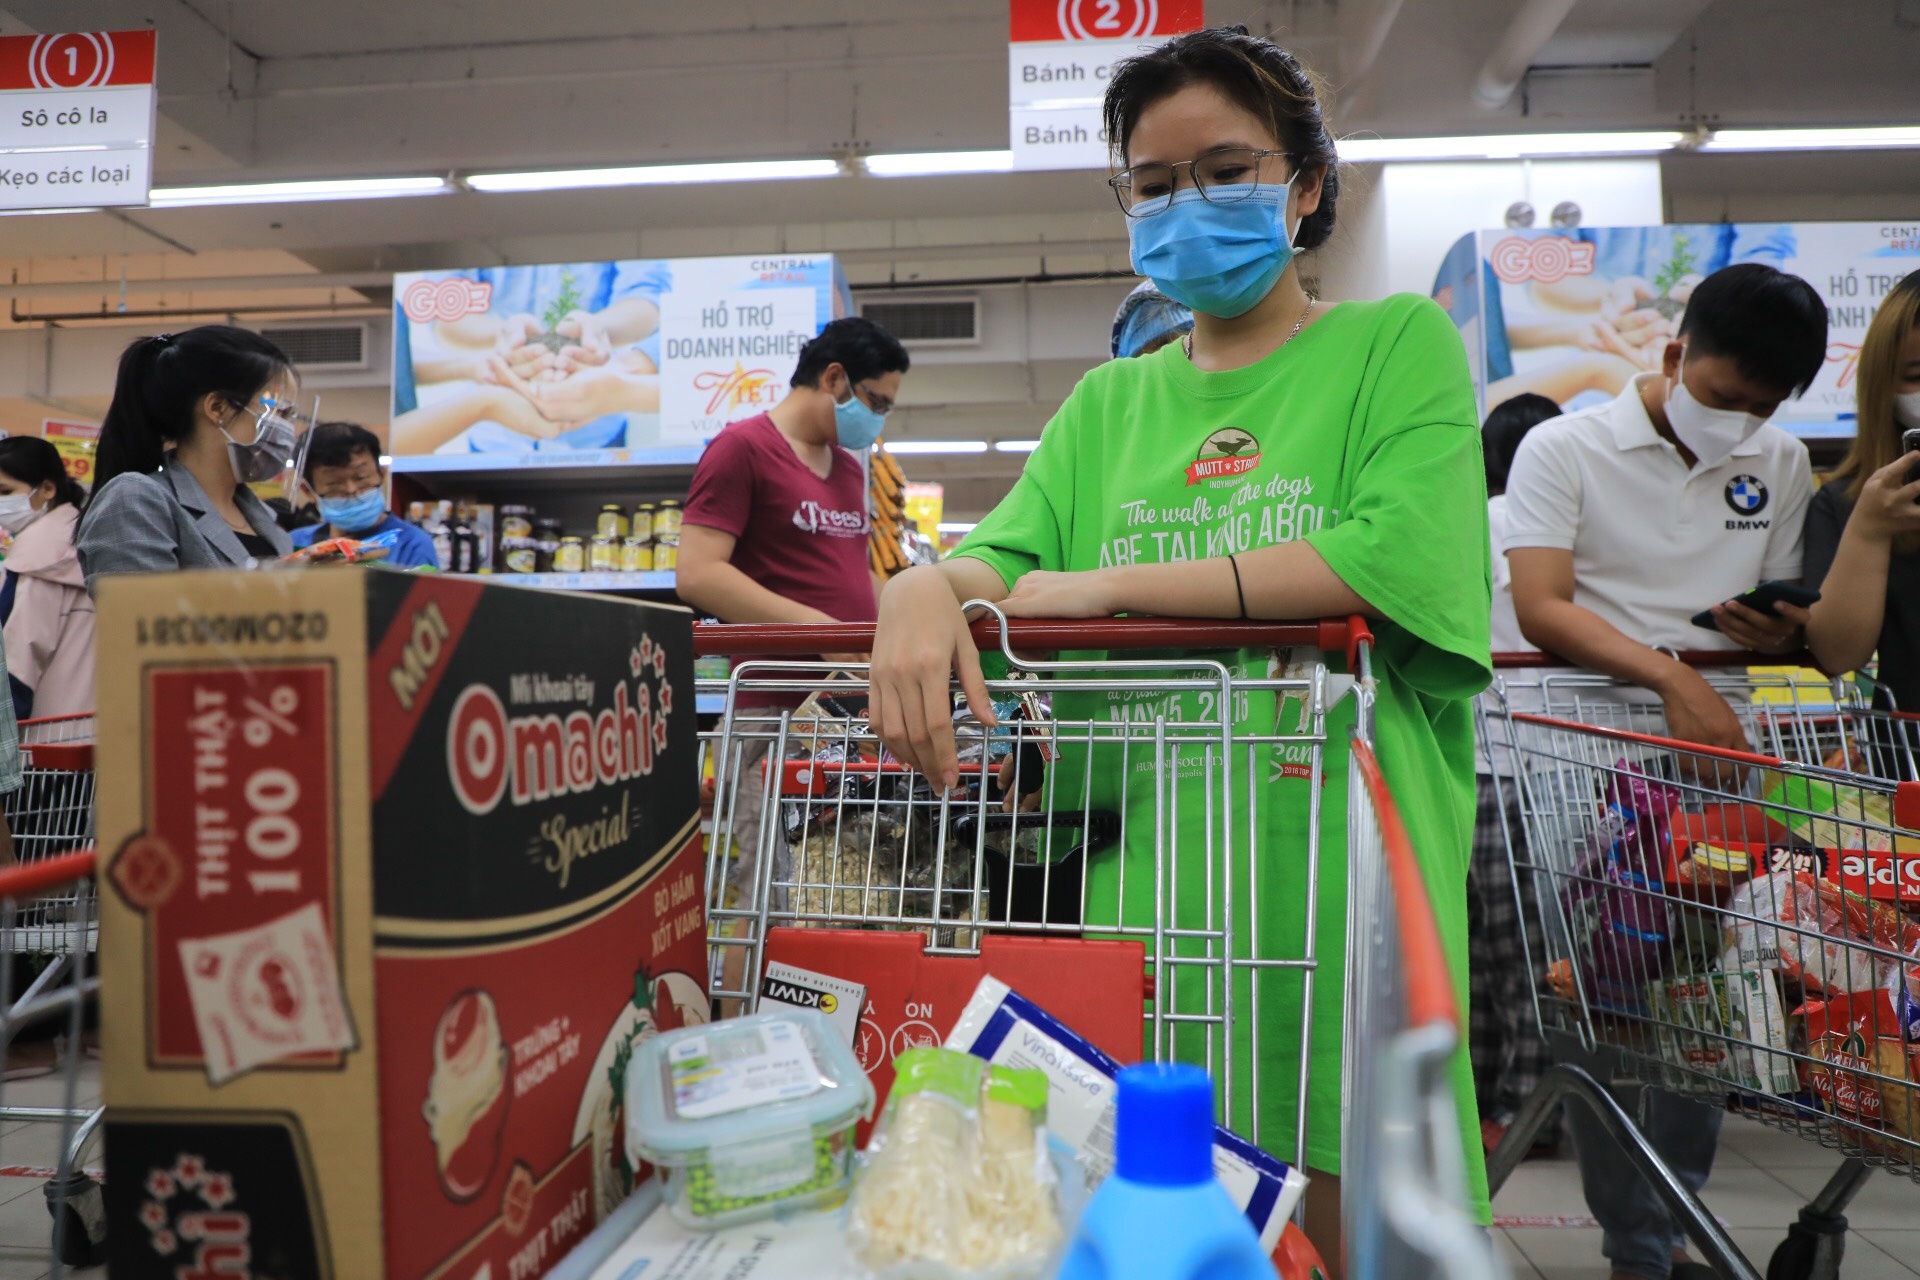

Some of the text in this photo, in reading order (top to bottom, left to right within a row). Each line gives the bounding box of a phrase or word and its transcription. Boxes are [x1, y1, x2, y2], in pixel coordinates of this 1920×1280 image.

[1093, 0, 1121, 29] 2
[64, 46, 78, 77] 1
[1022, 62, 1085, 83] Bánh
[21, 106, 108, 128] Sô cô la
[1024, 125, 1088, 144] Bánh
[0, 164, 131, 190] Kẹo các loại
[1880, 227, 1920, 238] CENT
[1891, 240, 1920, 251] RET
[750, 259, 816, 272] CENTRAL
[759, 271, 807, 283] RETAIL
[1830, 268, 1858, 297] HỖ
[701, 300, 774, 332] HỖ TRỢ
[1827, 305, 1866, 329] ANH
[667, 336, 735, 360] DOANH
[1195, 460, 1223, 477] MUTT
[1119, 499, 1158, 527] The
[1161, 495, 1215, 527] walk
[1265, 472, 1316, 509] dogs
[799, 500, 862, 534] Trees
[1725, 520, 1771, 530] BMW
[388, 600, 450, 711] MỚI
[446, 680, 653, 816] Omachi
[1177, 754, 1225, 769] SOCITY
[540, 789, 631, 889] Special
[1842, 856, 1920, 886] oPie
[768, 982, 820, 1008] KIWI
